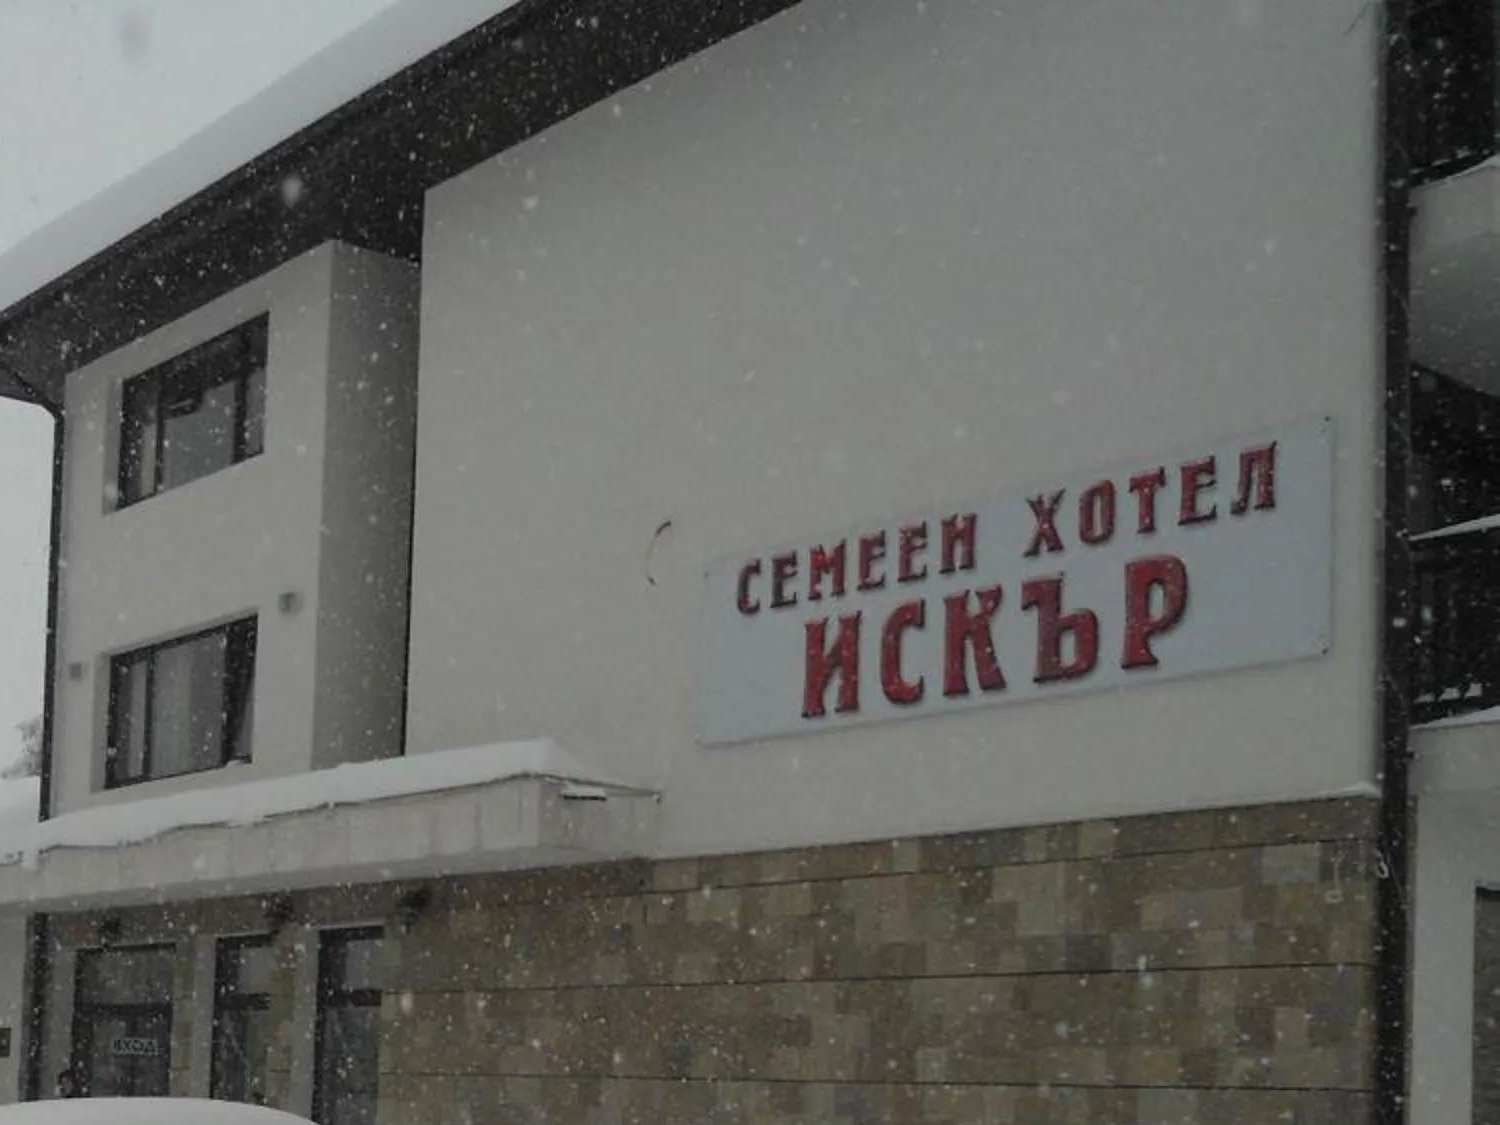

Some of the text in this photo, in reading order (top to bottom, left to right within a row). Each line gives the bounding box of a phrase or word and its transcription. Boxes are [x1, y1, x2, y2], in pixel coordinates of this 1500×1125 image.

[737, 441, 1277, 615] СЕМЕЕН ХОТЕЛ
[802, 554, 1189, 718] ИСКЪР
